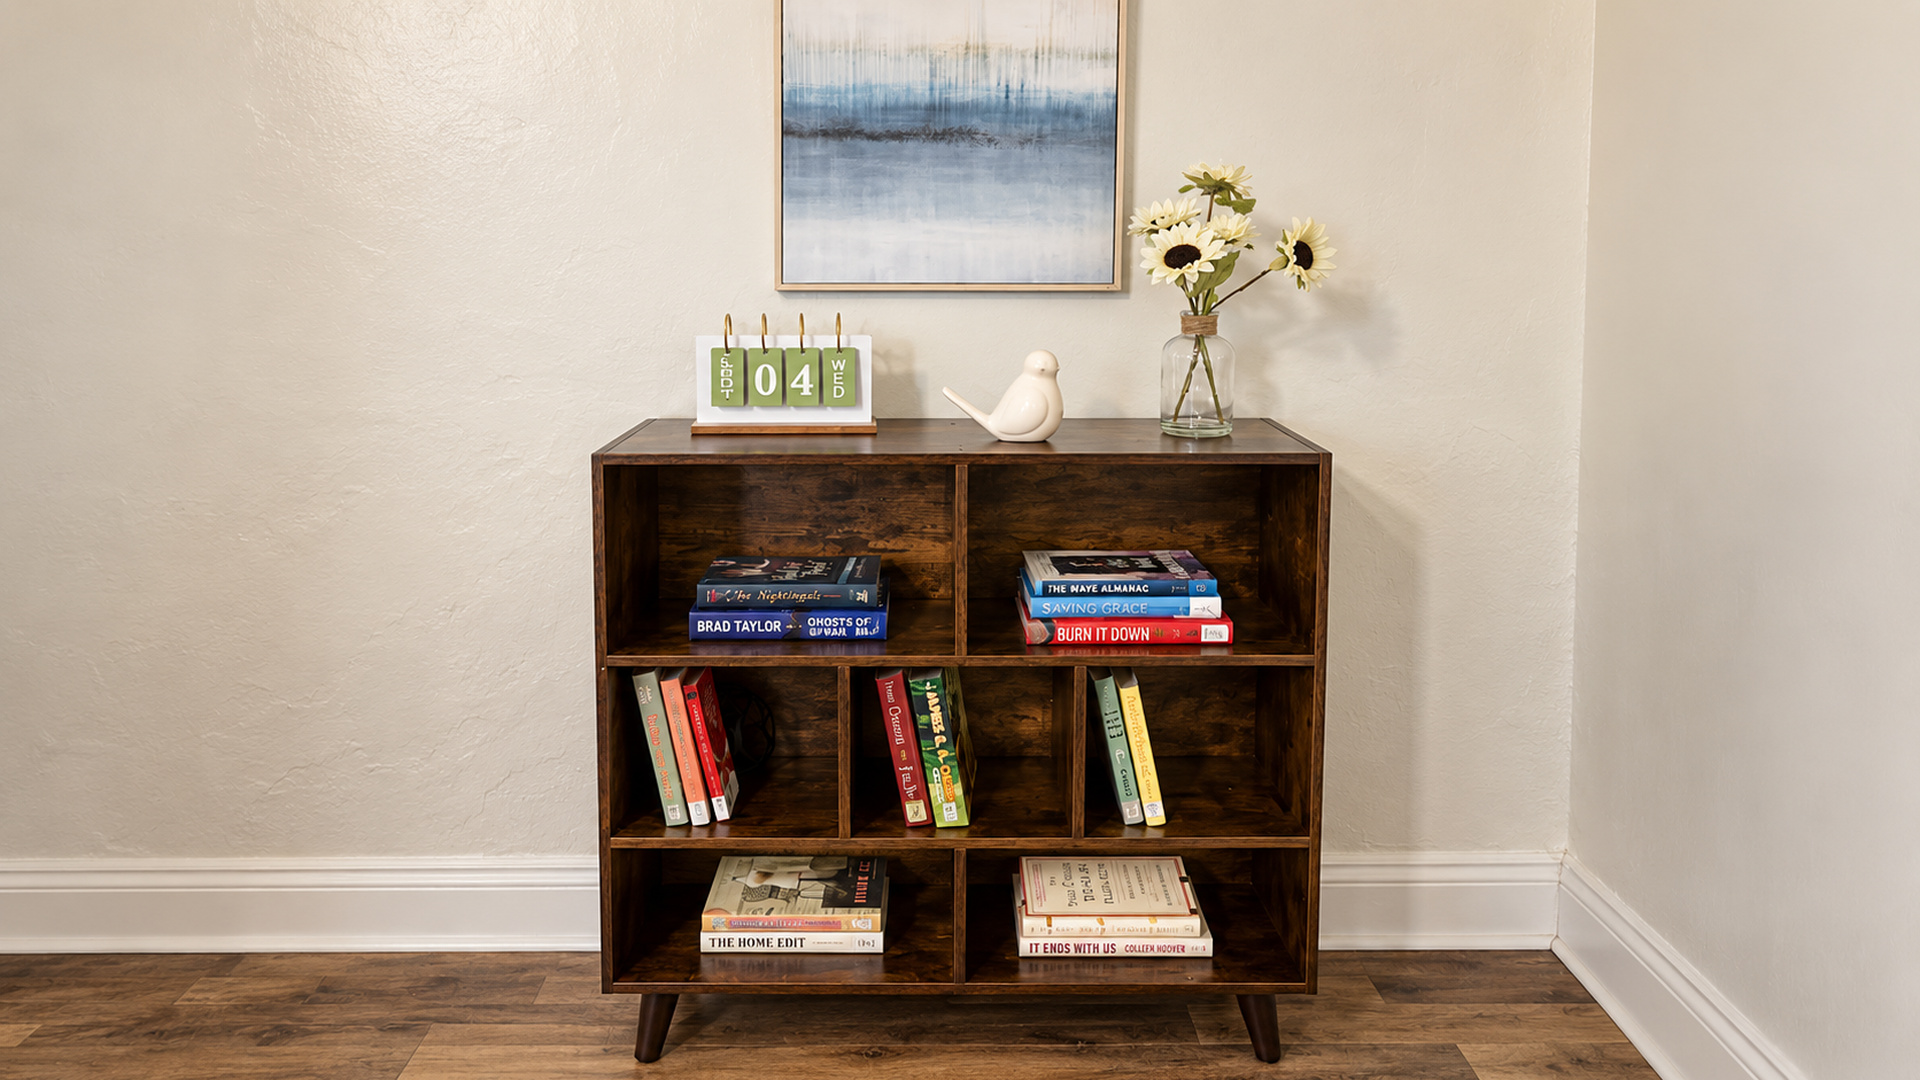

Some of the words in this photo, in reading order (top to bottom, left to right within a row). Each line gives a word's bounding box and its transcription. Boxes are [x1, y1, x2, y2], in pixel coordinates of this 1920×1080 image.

[831, 359, 846, 399] WED
[1101, 602, 1148, 615] GRACE
[697, 620, 731, 633] BRAD
[734, 620, 782, 633] TAYLOR
[1057, 626, 1092, 641] BURN
[1096, 626, 1109, 641] IT
[1111, 626, 1150, 641] DOWN
[708, 937, 735, 948] THE
[738, 937, 774, 948] HOME
[777, 937, 806, 948] EDIT
[1029, 942, 1040, 954] IT
[1043, 942, 1071, 954] ENDS
[1073, 942, 1100, 954] WITH
[1103, 942, 1117, 954] US
